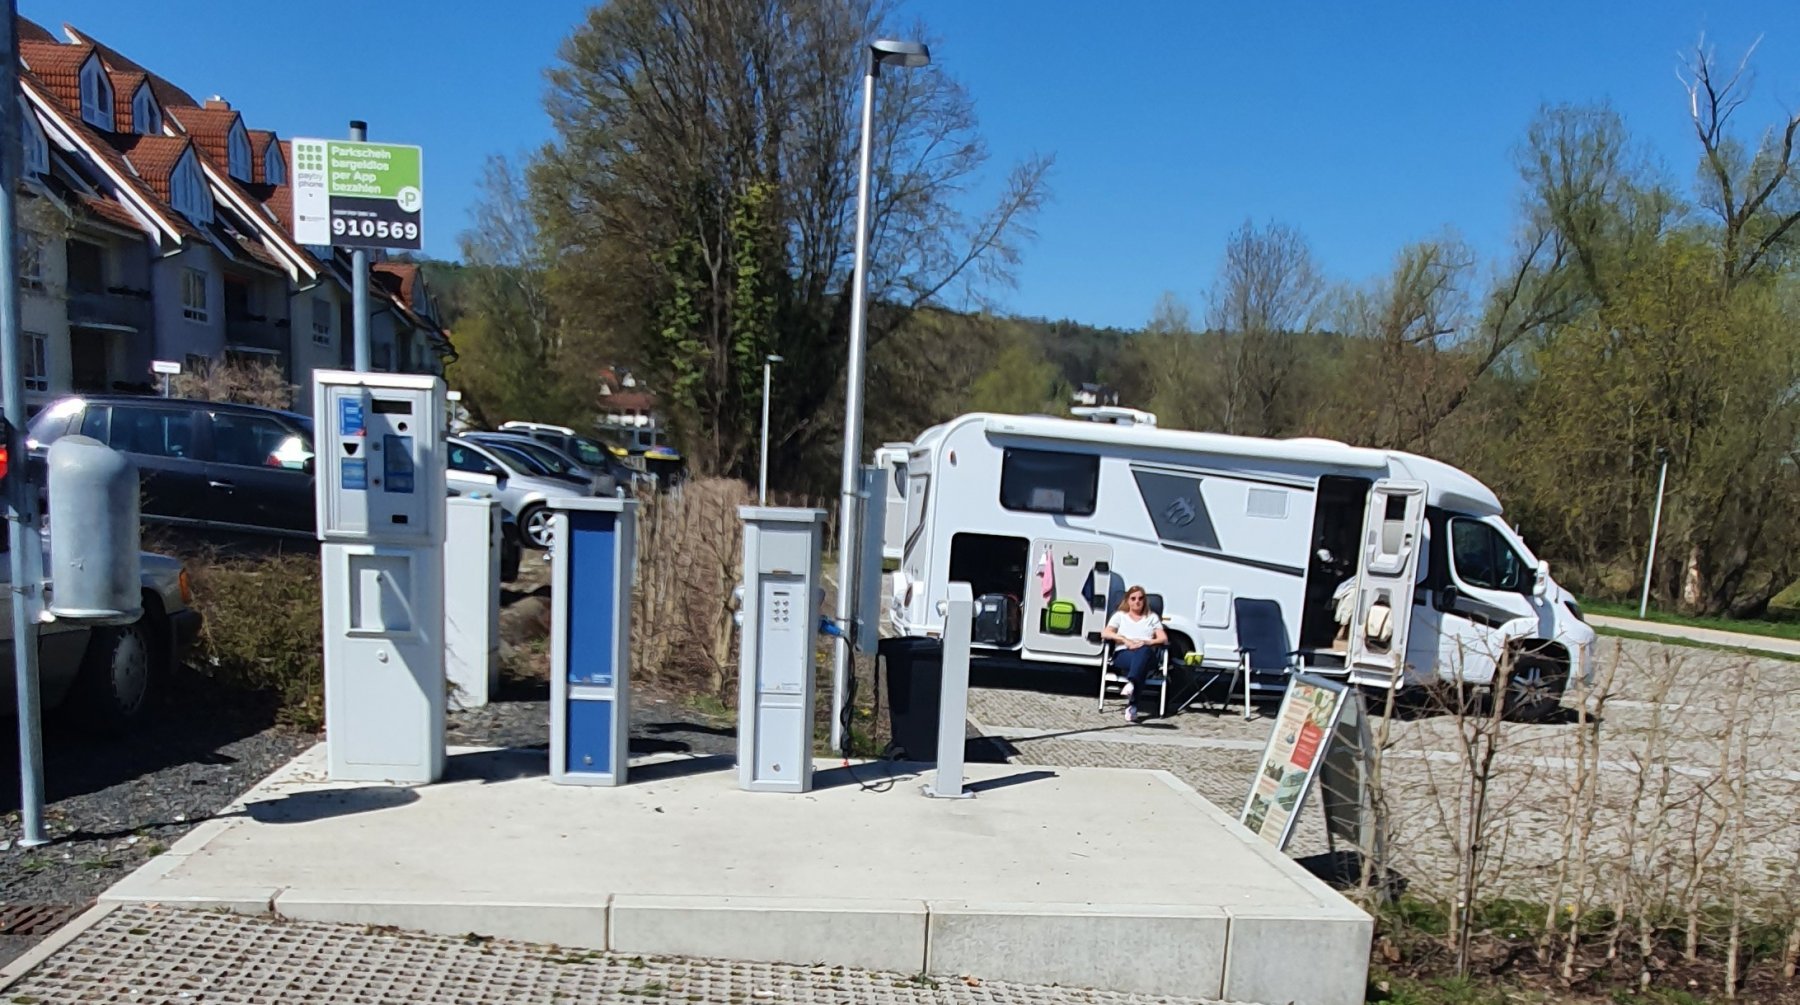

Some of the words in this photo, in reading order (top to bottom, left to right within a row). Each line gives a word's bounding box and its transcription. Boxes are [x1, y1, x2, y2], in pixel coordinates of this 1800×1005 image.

[331, 146, 391, 159] Parkschein
[331, 157, 389, 171] bargeldlos
[332, 171, 351, 182] per
[353, 171, 376, 183] App
[332, 182, 381, 194] bezahlen
[332, 218, 418, 240] 910569
